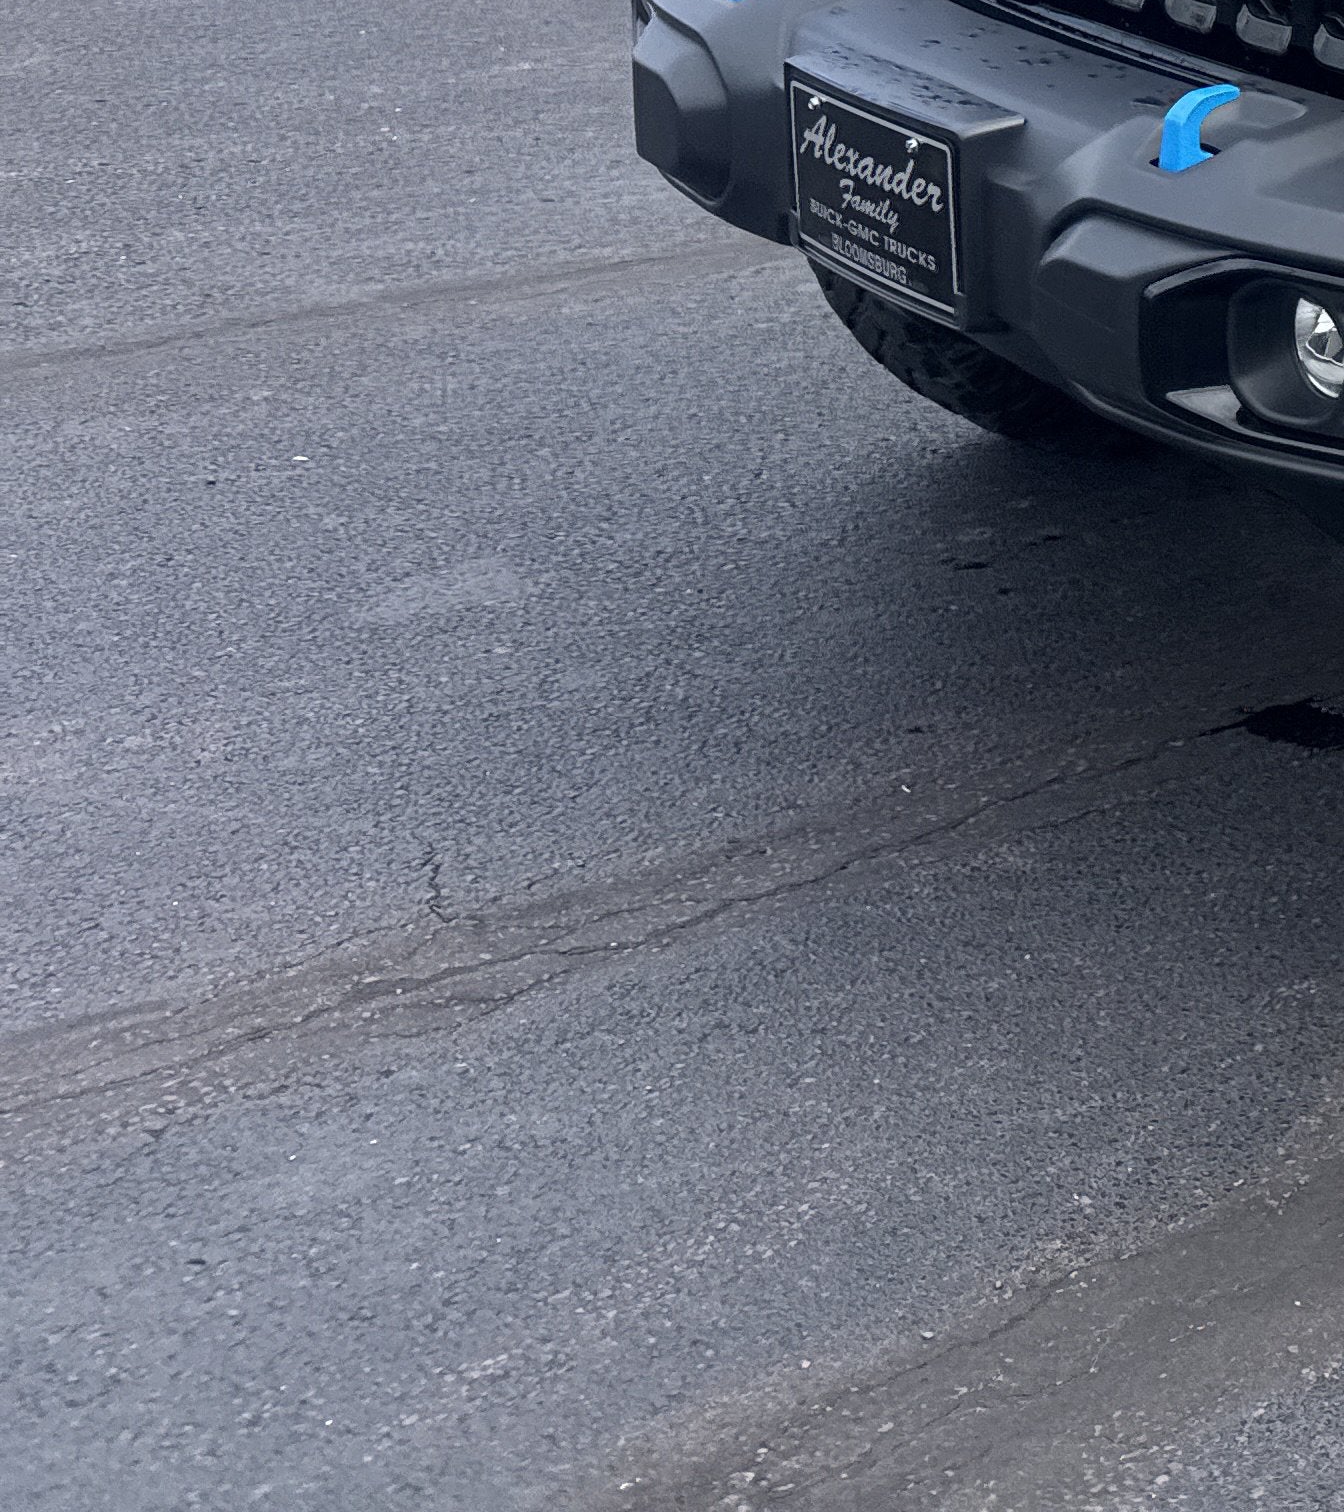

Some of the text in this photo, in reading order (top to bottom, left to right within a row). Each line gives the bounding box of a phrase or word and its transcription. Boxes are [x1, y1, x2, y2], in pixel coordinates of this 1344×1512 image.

[800, 115, 945, 213] Alexander
[839, 178, 899, 234] Family
[831, 231, 908, 285] BLOOMSBURG
[882, 234, 938, 272] TRUCKS
